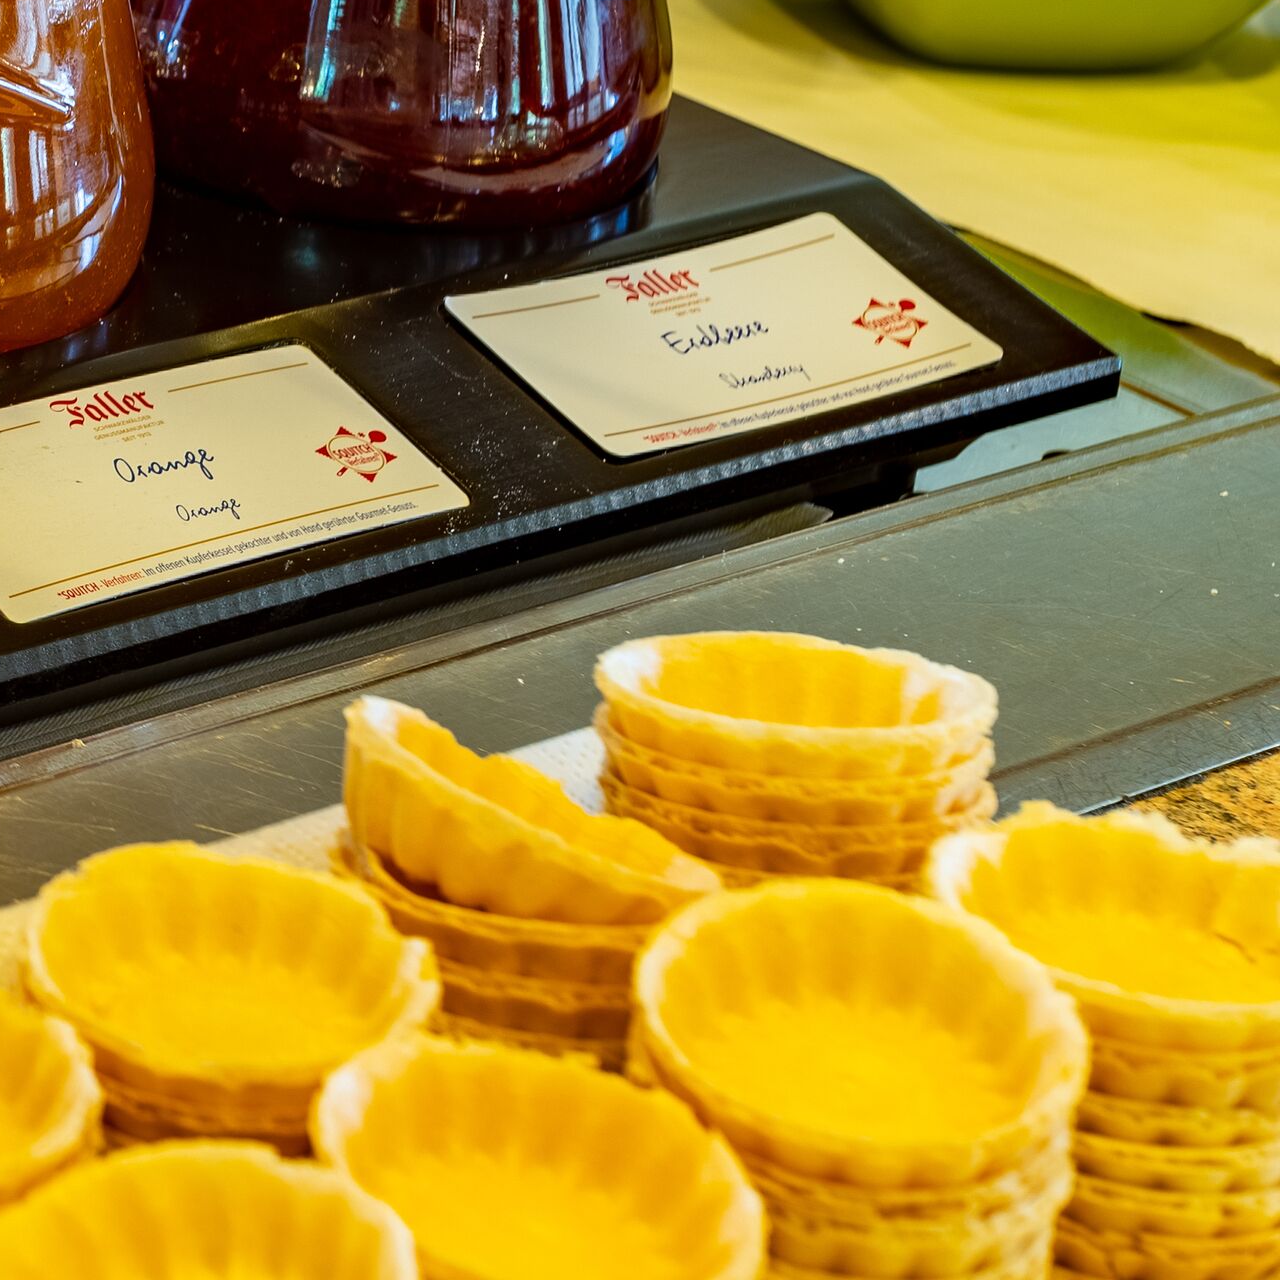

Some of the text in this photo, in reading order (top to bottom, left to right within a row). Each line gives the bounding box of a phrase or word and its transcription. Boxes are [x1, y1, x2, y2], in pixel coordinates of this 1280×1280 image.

[606, 269, 699, 303] Faller
[660, 321, 768, 355] Erdbeere
[49, 390, 154, 429] Faller
[113, 448, 214, 483] Orange
[176, 498, 240, 521] Orange
[155, 559, 186, 574] offenen
[185, 544, 235, 565] Kupferkessel
[237, 536, 272, 554] gekochter
[273, 531, 289, 542] und
[287, 528, 302, 538] von
[301, 522, 324, 535] Hand
